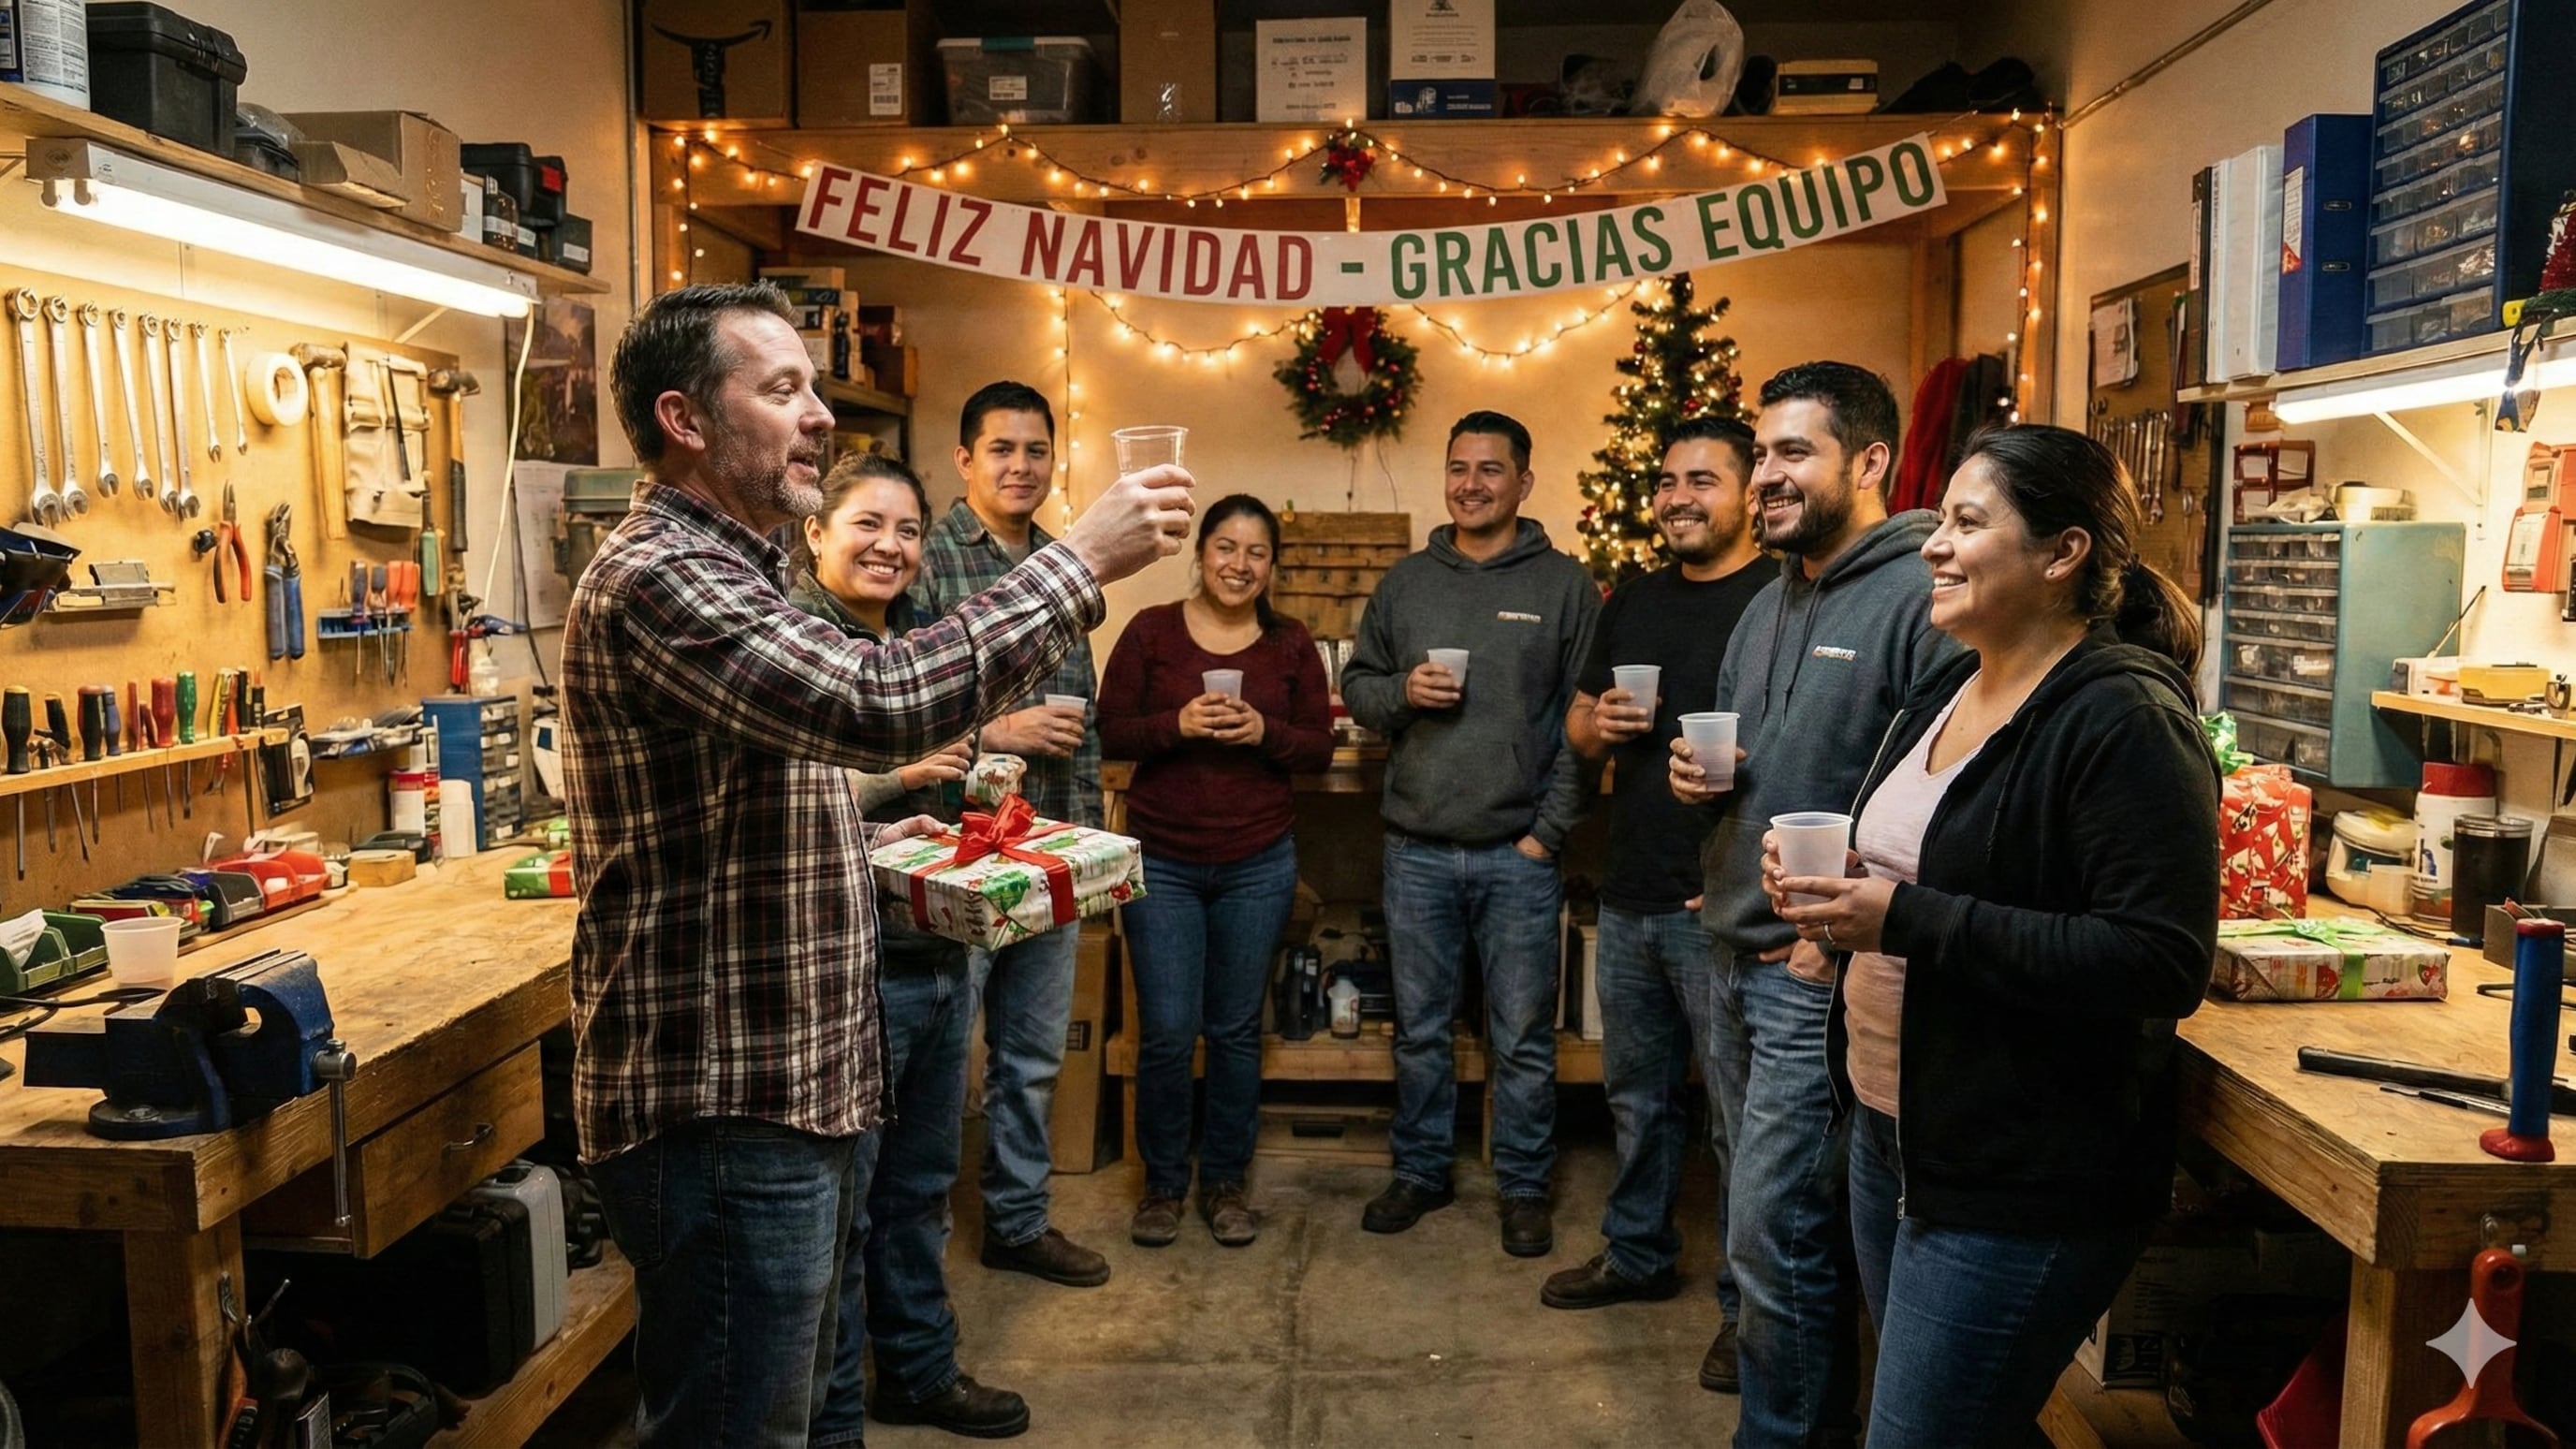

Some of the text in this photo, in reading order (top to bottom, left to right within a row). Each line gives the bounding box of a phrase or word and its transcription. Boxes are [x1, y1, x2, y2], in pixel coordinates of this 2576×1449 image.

[808, 142, 1935, 300] FELIZ NAVIDAD - GRACIAS EQUIPO
